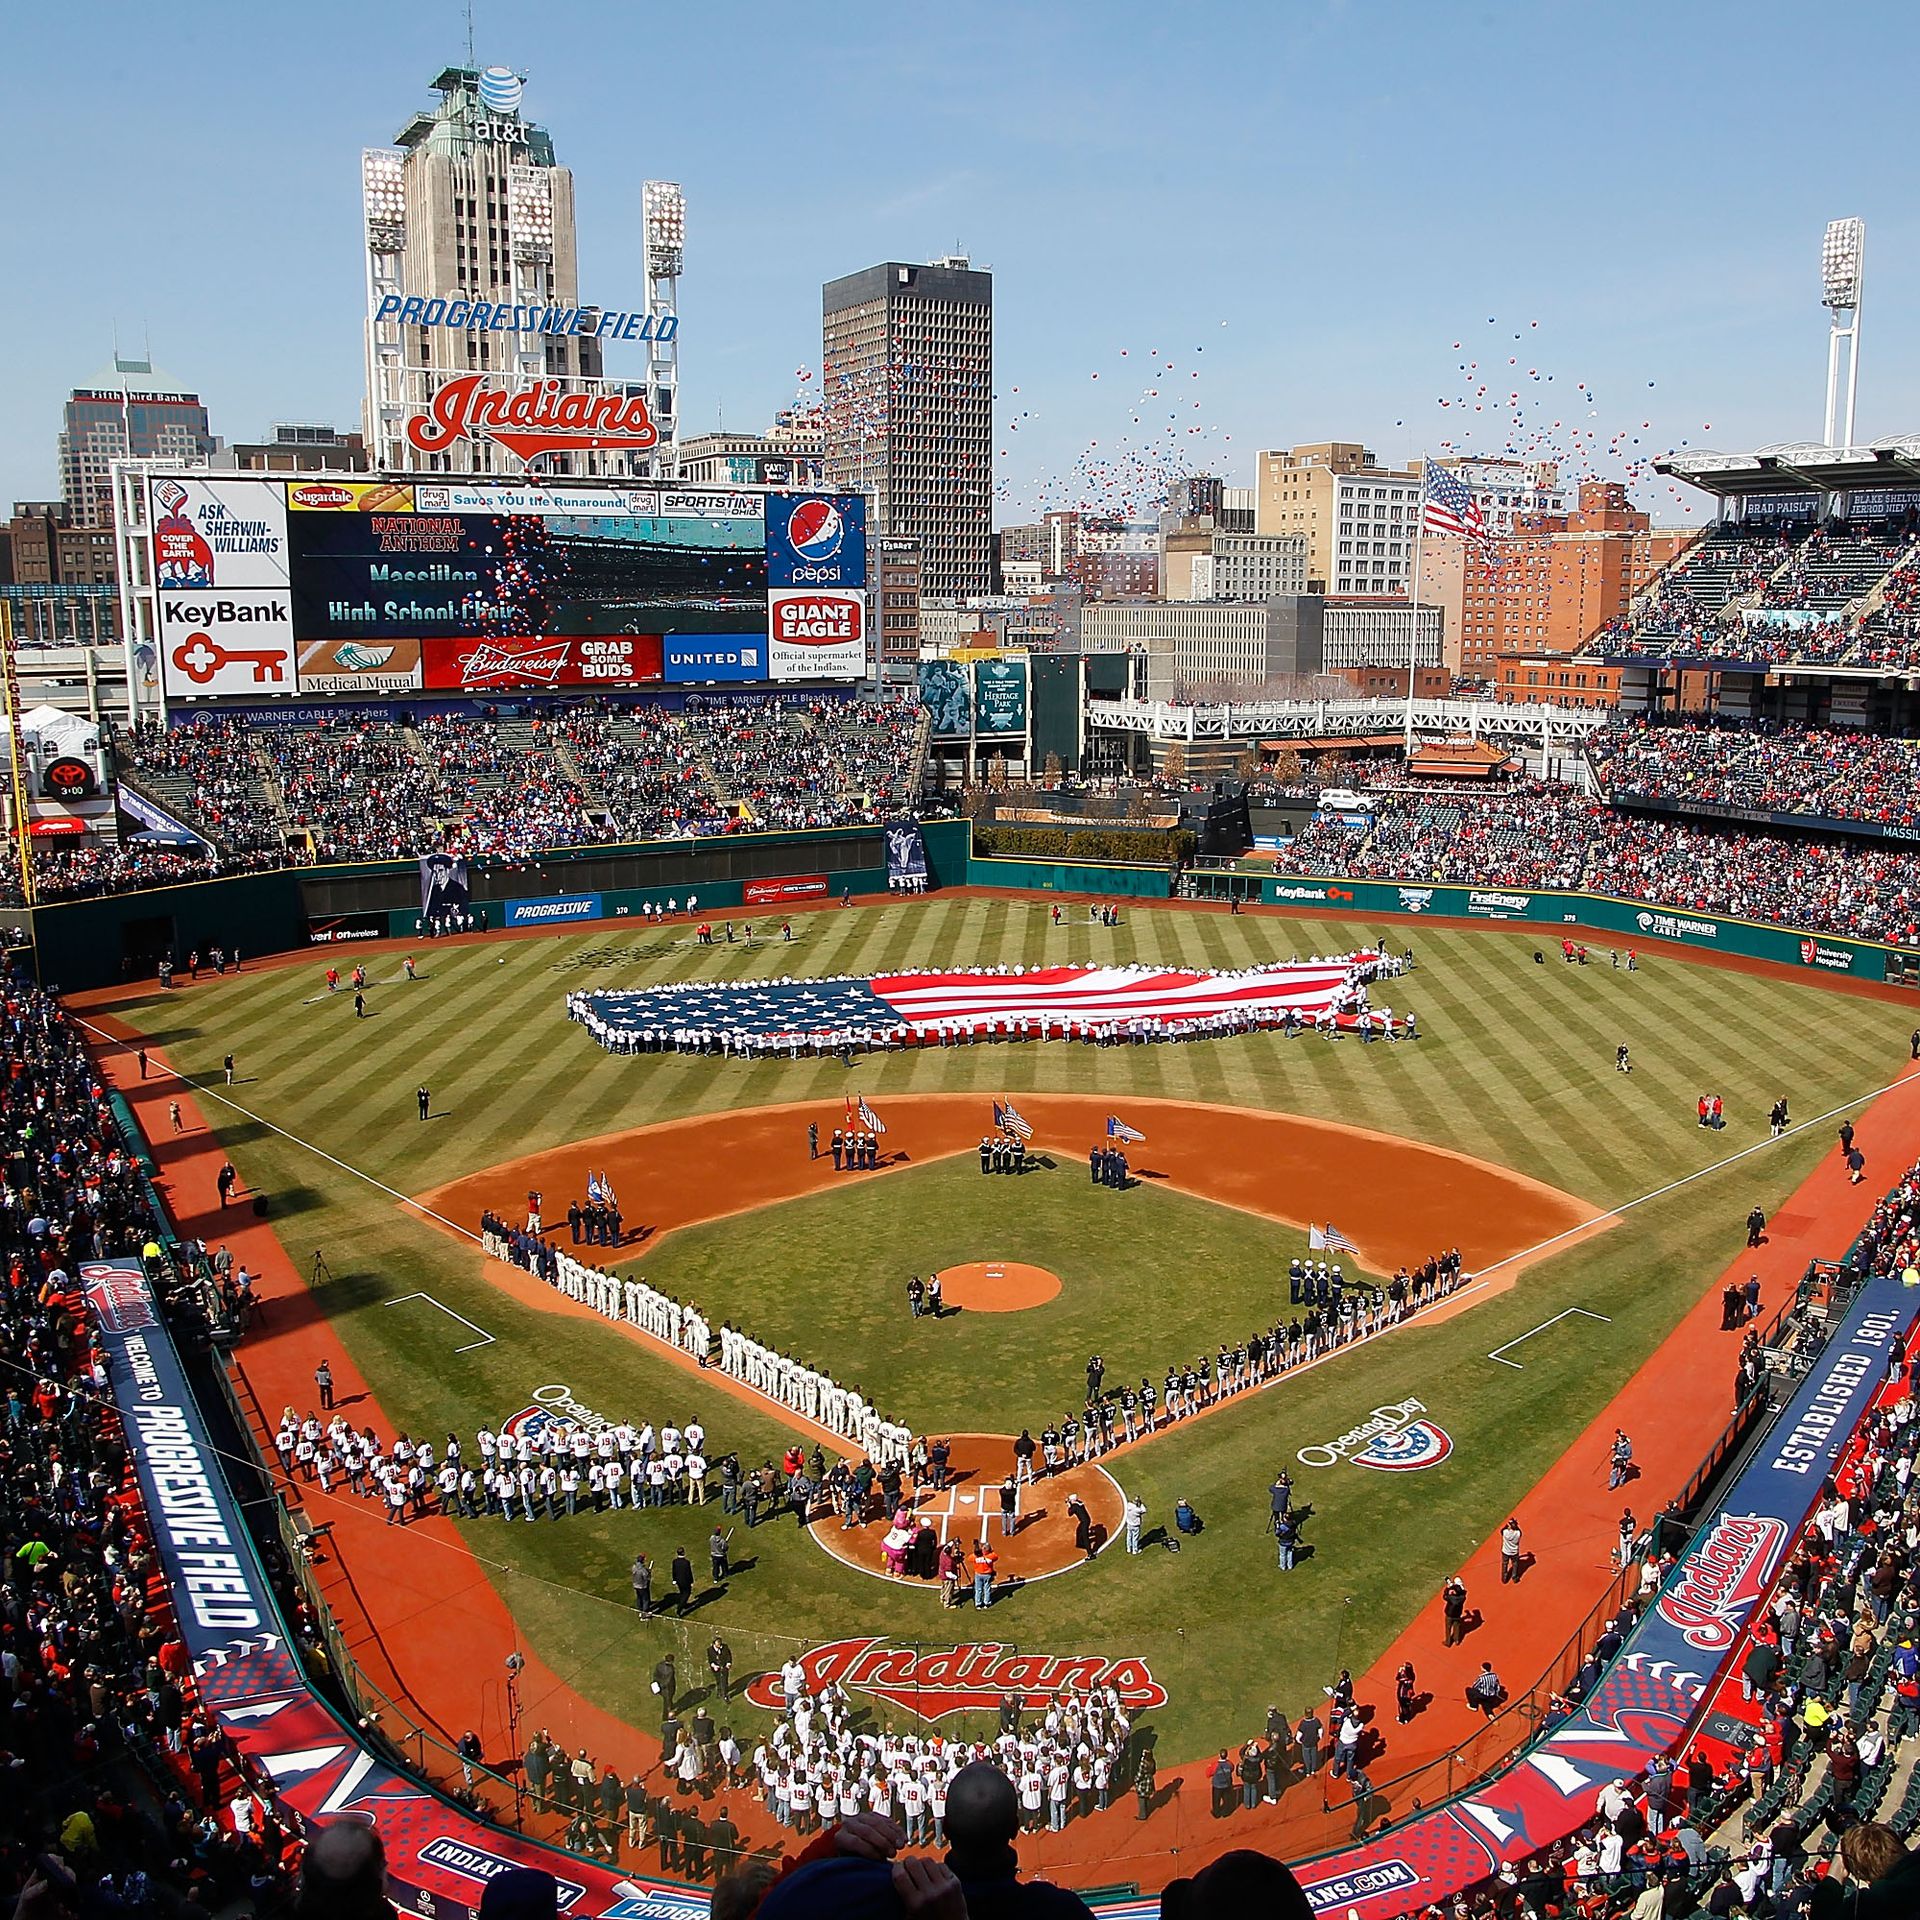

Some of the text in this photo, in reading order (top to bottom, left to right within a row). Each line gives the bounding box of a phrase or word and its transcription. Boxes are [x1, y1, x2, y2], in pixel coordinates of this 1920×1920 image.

[475, 118, 530, 145] at&t
[374, 294, 680, 342] PROGRESSIVE FIELD
[91, 391, 185, 403] Fifth hird Bank
[407, 374, 659, 460] Indians
[294, 486, 353, 504] Sugardale
[422, 488, 444, 502] drug
[1854, 494, 1883, 504] BLAKE
[424, 499, 449, 508] mart
[453, 494, 626, 509] Saves YOU the Runaround!
[630, 495, 651, 508] drug
[664, 494, 763, 510] SPORTSTIME
[1747, 501, 1818, 514] BRAD PAISLEY
[197, 504, 226, 520] ASK
[632, 504, 655, 513] mart
[731, 508, 758, 517] OHIO
[1850, 504, 1884, 514] JERROD
[204, 521, 272, 537] SHERWIN-
[370, 517, 467, 535] NATIONAL
[160, 534, 194, 543] COVER
[379, 535, 460, 552] ANTHEM
[168, 542, 188, 550] THE
[162, 549, 195, 558] EARTH
[792, 564, 841, 583] pepsi
[165, 601, 288, 628] KeyBank
[780, 604, 853, 621] GIANT
[782, 621, 852, 638] EAGLE
[580, 641, 634, 656] GRAB
[590, 654, 625, 664] SOME
[670, 653, 738, 665] UNITED
[772, 650, 862, 663] Official supermarket
[458, 653, 568, 673] Budweiser
[786, 661, 849, 672] of the Indians.
[581, 663, 634, 678] BUDS
[307, 673, 415, 690] Medical Mutual
[5, 640, 25, 764] WALGREENS
[704, 696, 728, 706] TIME
[248, 709, 334, 722] WARNER CABLE
[1447, 737, 1476, 746] JOBSITE
[1882, 825, 1920, 842] MASSIL
[1276, 885, 1327, 900] KeyBank
[1469, 891, 1531, 908] FirstEnergy
[513, 900, 594, 919] PROGRESSIVE
[616, 906, 629, 915] 370
[1563, 914, 1577, 922] 375
[1653, 913, 1718, 936] TIME WARNER
[309, 926, 350, 942] verizon
[1652, 926, 1682, 938] CABLE
[1816, 947, 1854, 962] University
[1815, 956, 1850, 969] Hospitals
[123, 1334, 163, 1401] WELCOME TO
[807, 1377, 814, 1385] 19
[834, 1394, 841, 1402] 19
[1771, 1353, 1872, 1475] ESTABLISHED
[664, 1432, 672, 1441] 19
[689, 1430, 698, 1439] 19
[897, 1433, 905, 1441] 19
[1296, 1395, 1428, 1468] Opening Day
[500, 1439, 509, 1448] 19
[557, 1437, 566, 1446] 19
[577, 1437, 586, 1446] 19
[602, 1437, 610, 1446] 19
[303, 1445, 311, 1454] 19
[653, 1463, 662, 1473] 19
[669, 1460, 678, 1469] 19
[387, 1468, 395, 1477] 19
[610, 1467, 619, 1476] 19
[389, 1487, 398, 1496] 19
[132, 1404, 262, 1629] PROGRESSIVE FIELD
[1655, 1510, 1789, 1652] Indians
[744, 1635, 1168, 1723] Indians
[885, 1740, 895, 1752] 19
[1004, 1742, 1014, 1754] 19
[829, 1770, 839, 1782] 19
[777, 1777, 788, 1788] 19
[1028, 1780, 1039, 1792] 19
[793, 1789, 805, 1800] 19
[841, 1788, 852, 1799] 19
[907, 1789, 918, 1801] 19
[935, 1789, 947, 1801] 19
